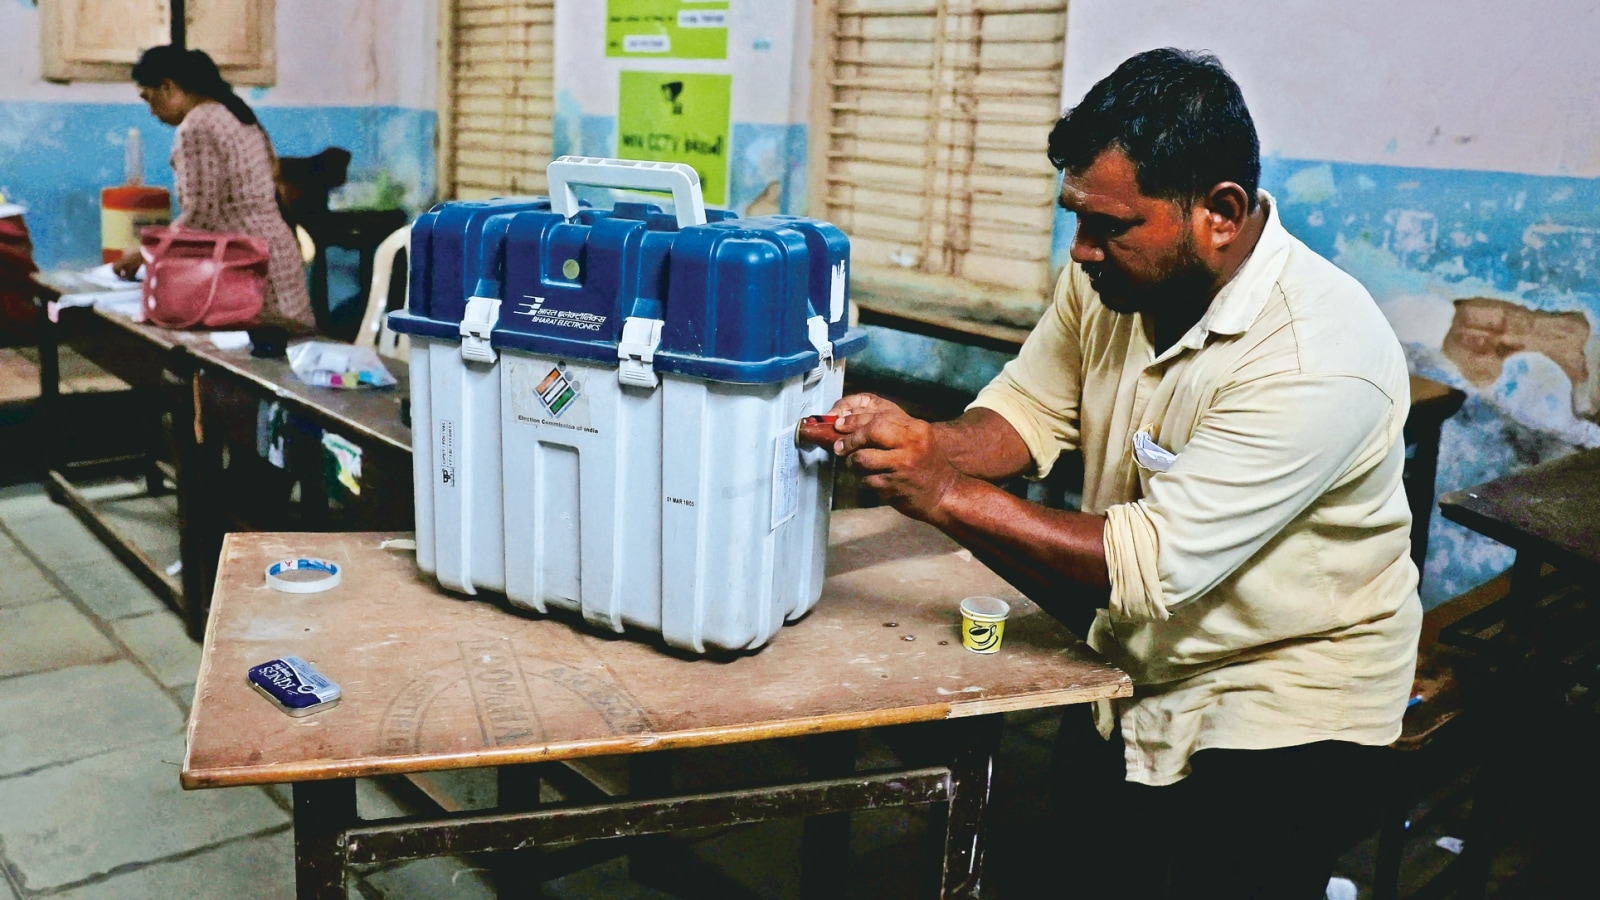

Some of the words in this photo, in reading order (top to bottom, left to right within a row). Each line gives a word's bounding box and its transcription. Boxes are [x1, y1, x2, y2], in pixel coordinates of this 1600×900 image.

[532, 316, 557, 325] BHARAT
[557, 320, 601, 331] ELECTRONICS
[518, 415, 540, 424] Election
[541, 419, 576, 430] Commission
